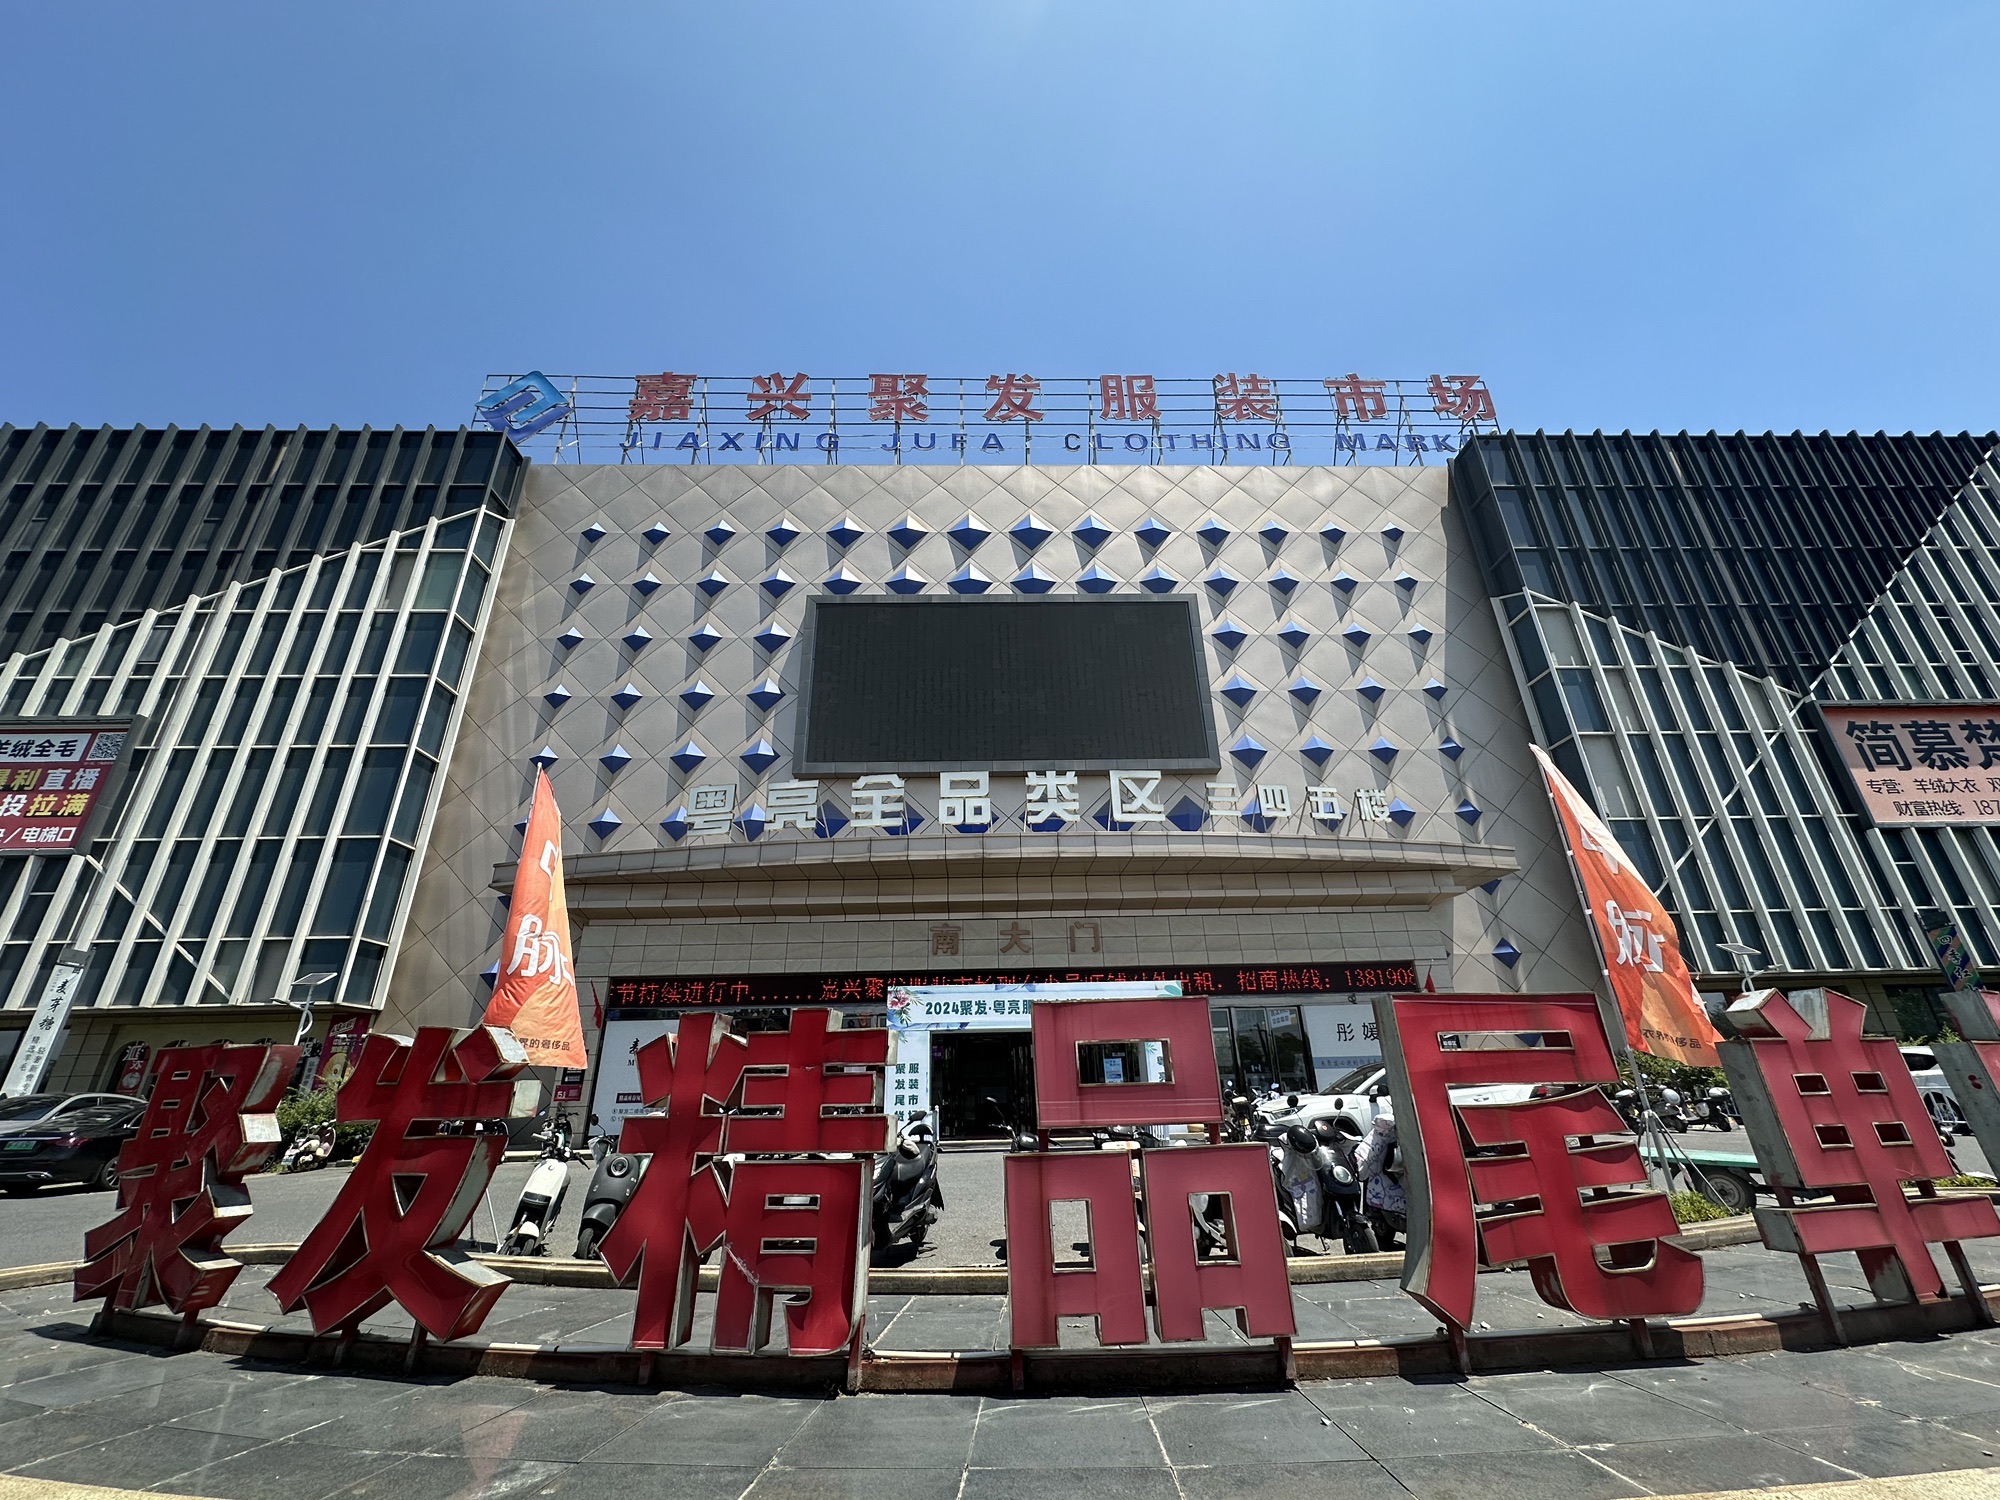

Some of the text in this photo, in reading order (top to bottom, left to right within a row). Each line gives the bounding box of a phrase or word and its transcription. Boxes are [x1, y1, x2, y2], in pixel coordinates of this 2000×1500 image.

[628, 371, 1497, 422] 嘉兴聚发服装市场
[619, 431, 841, 451] JIAXING
[881, 431, 1005, 452] JUFA
[1064, 432, 1291, 452] CLOTHING
[1913, 777, 1980, 794] 羊绒大衣
[929, 921, 1100, 956] 南大门
[74, 987, 2000, 1356] 聚发精品尾单
